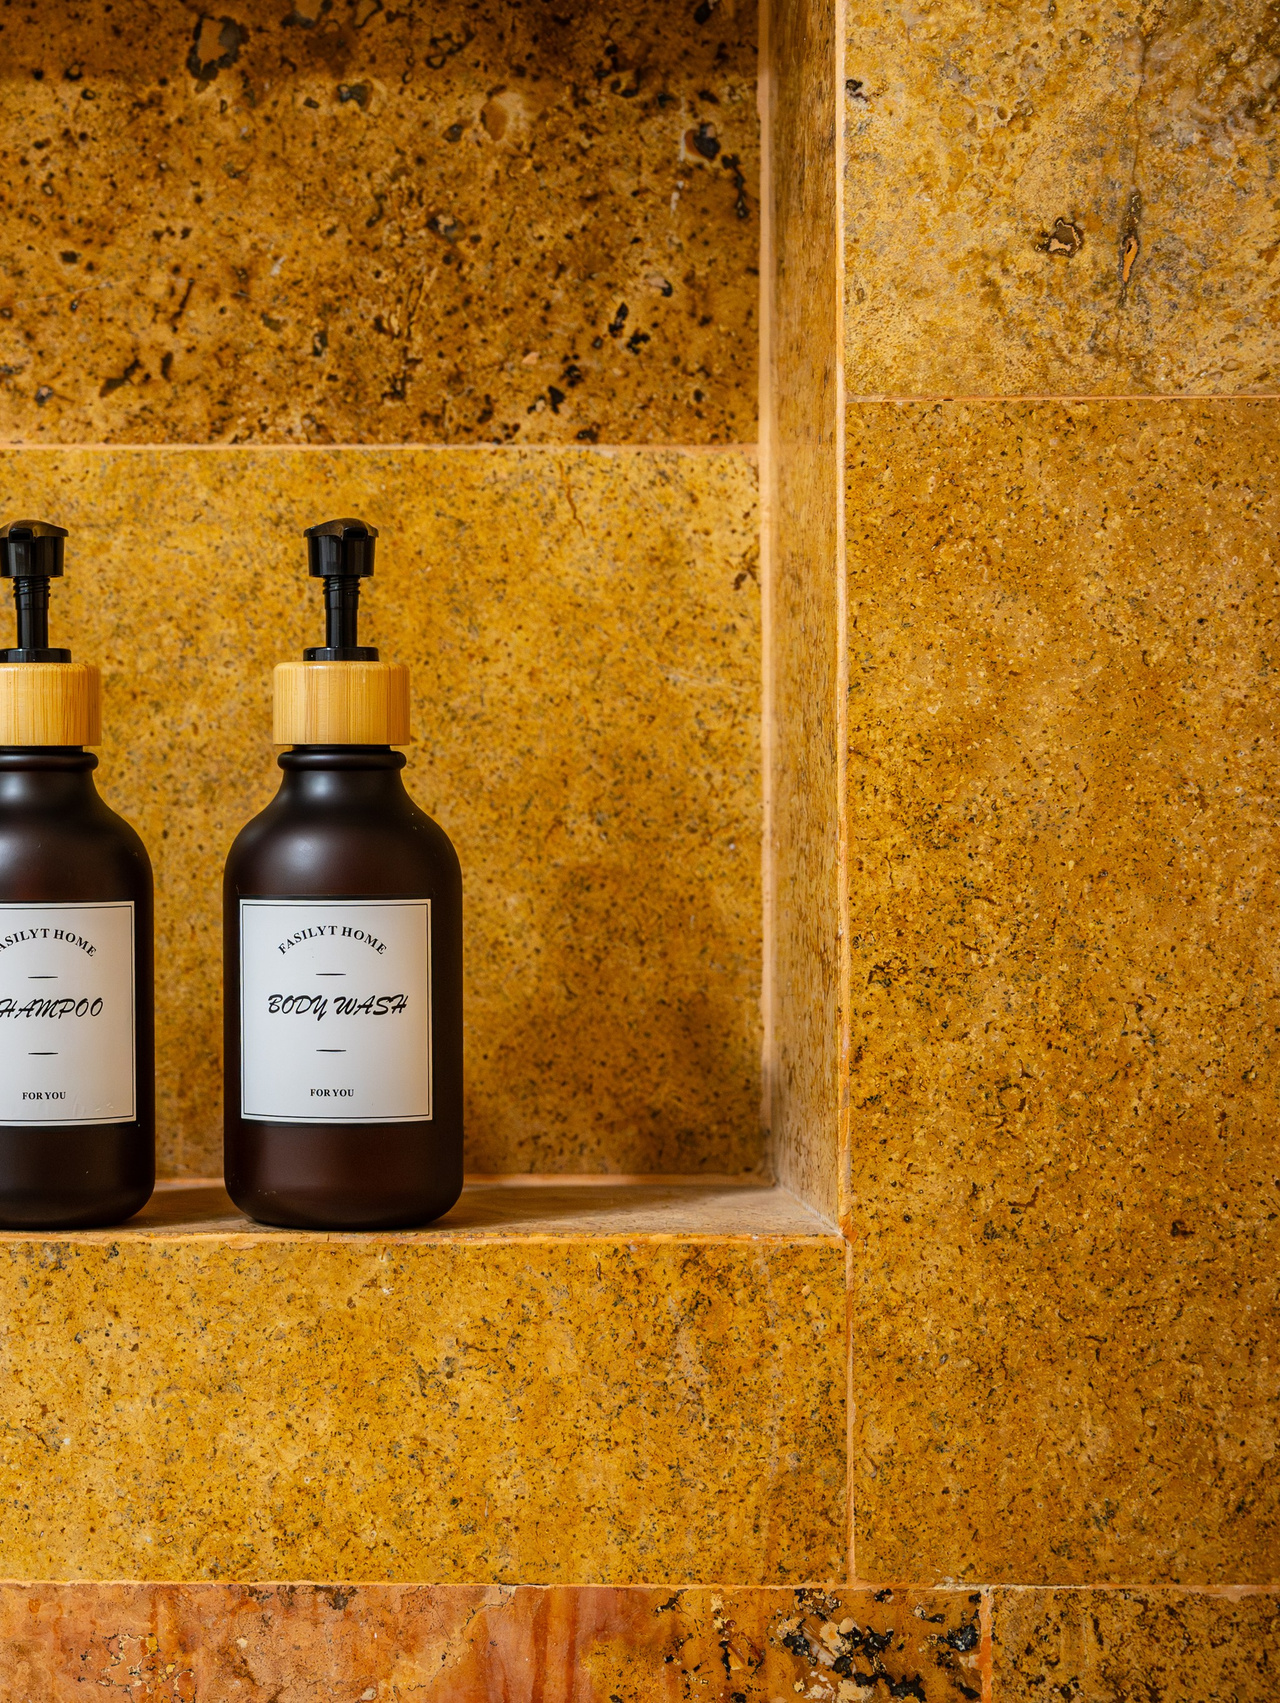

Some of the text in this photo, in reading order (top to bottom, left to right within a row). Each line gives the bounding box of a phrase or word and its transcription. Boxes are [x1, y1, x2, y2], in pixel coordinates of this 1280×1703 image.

[53, 928, 97, 958] HOME
[278, 925, 387, 955] FASILYT HOME
[267, 994, 409, 1021] BODY WASH
[22, 1091, 67, 1100] FOR YOU
[310, 1088, 355, 1097] FOR YOU
